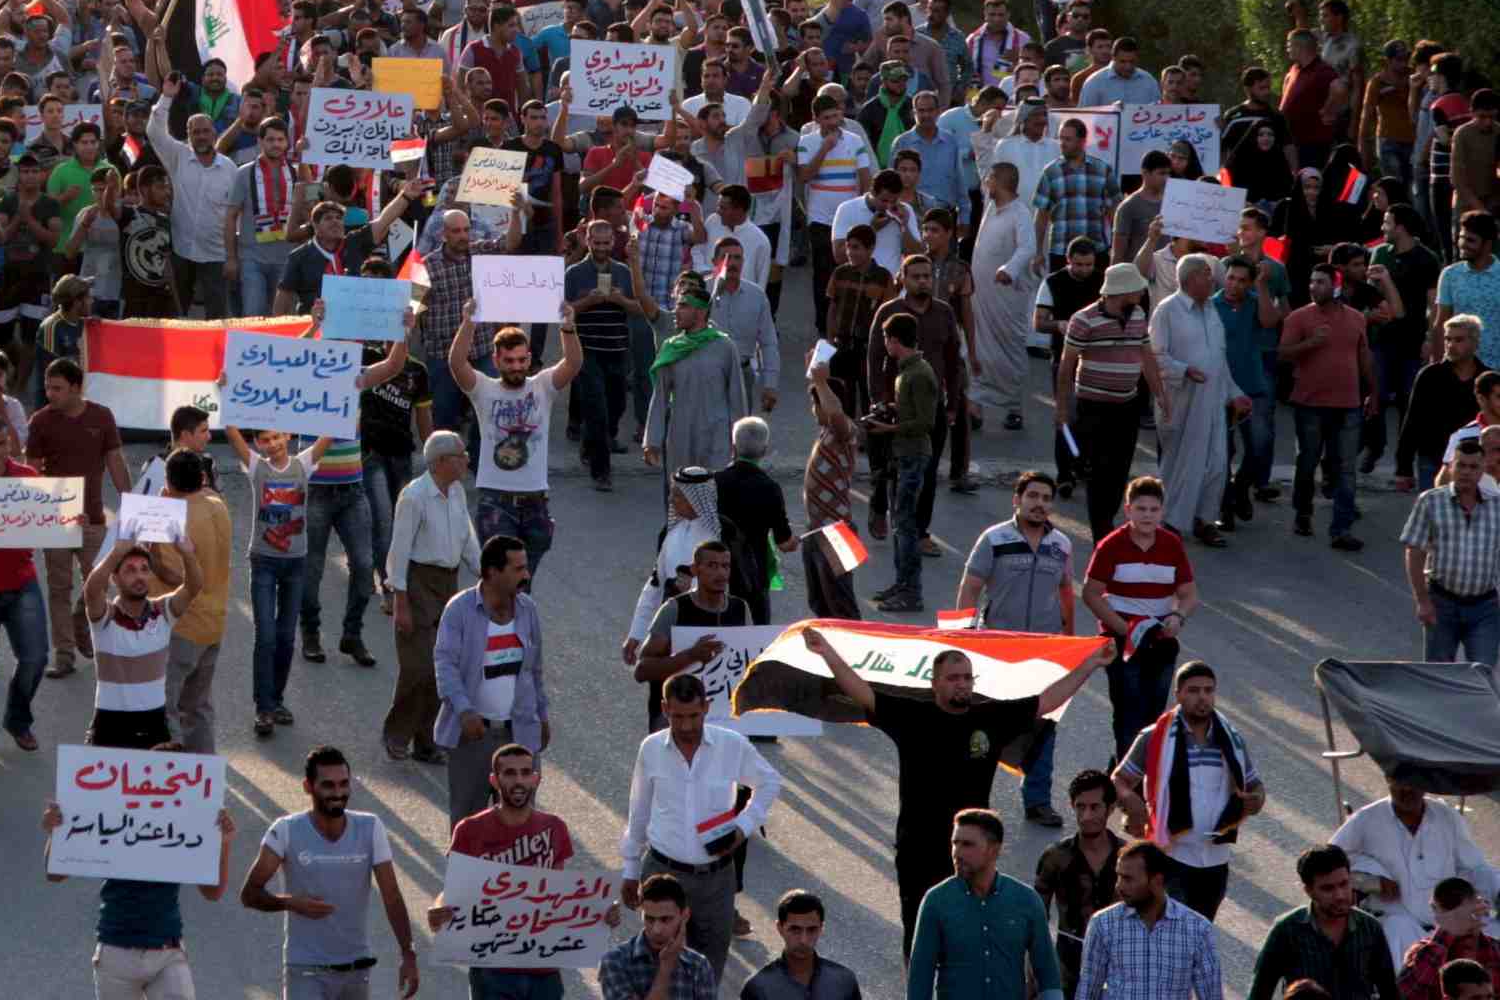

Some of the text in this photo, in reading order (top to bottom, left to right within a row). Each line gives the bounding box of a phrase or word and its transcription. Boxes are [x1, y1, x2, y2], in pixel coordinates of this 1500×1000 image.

[316, 347, 353, 379] رافع
[74, 760, 213, 809] النجيفيان
[123, 821, 204, 849] دواعش
[481, 871, 612, 910] الفهداوي
